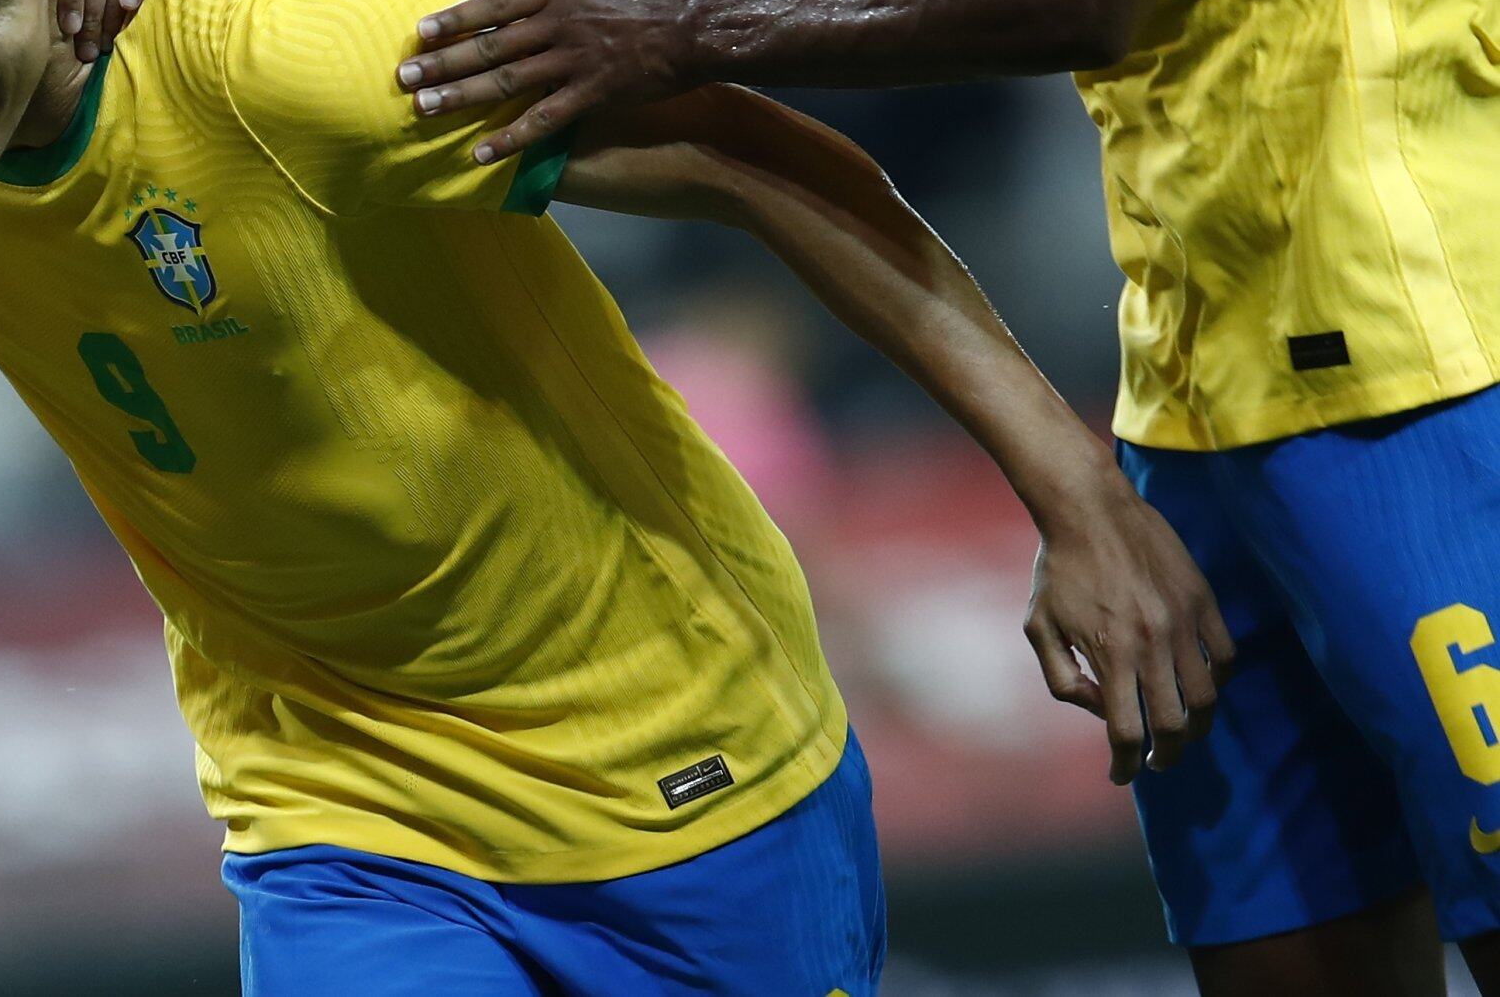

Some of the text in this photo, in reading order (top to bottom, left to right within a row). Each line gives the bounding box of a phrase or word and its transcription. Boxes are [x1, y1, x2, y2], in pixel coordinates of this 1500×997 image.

[161, 250, 187, 265] CBF
[171, 316, 249, 345] BRASIL
[76, 332, 197, 474] 9
[1409, 602, 1500, 786] 6
